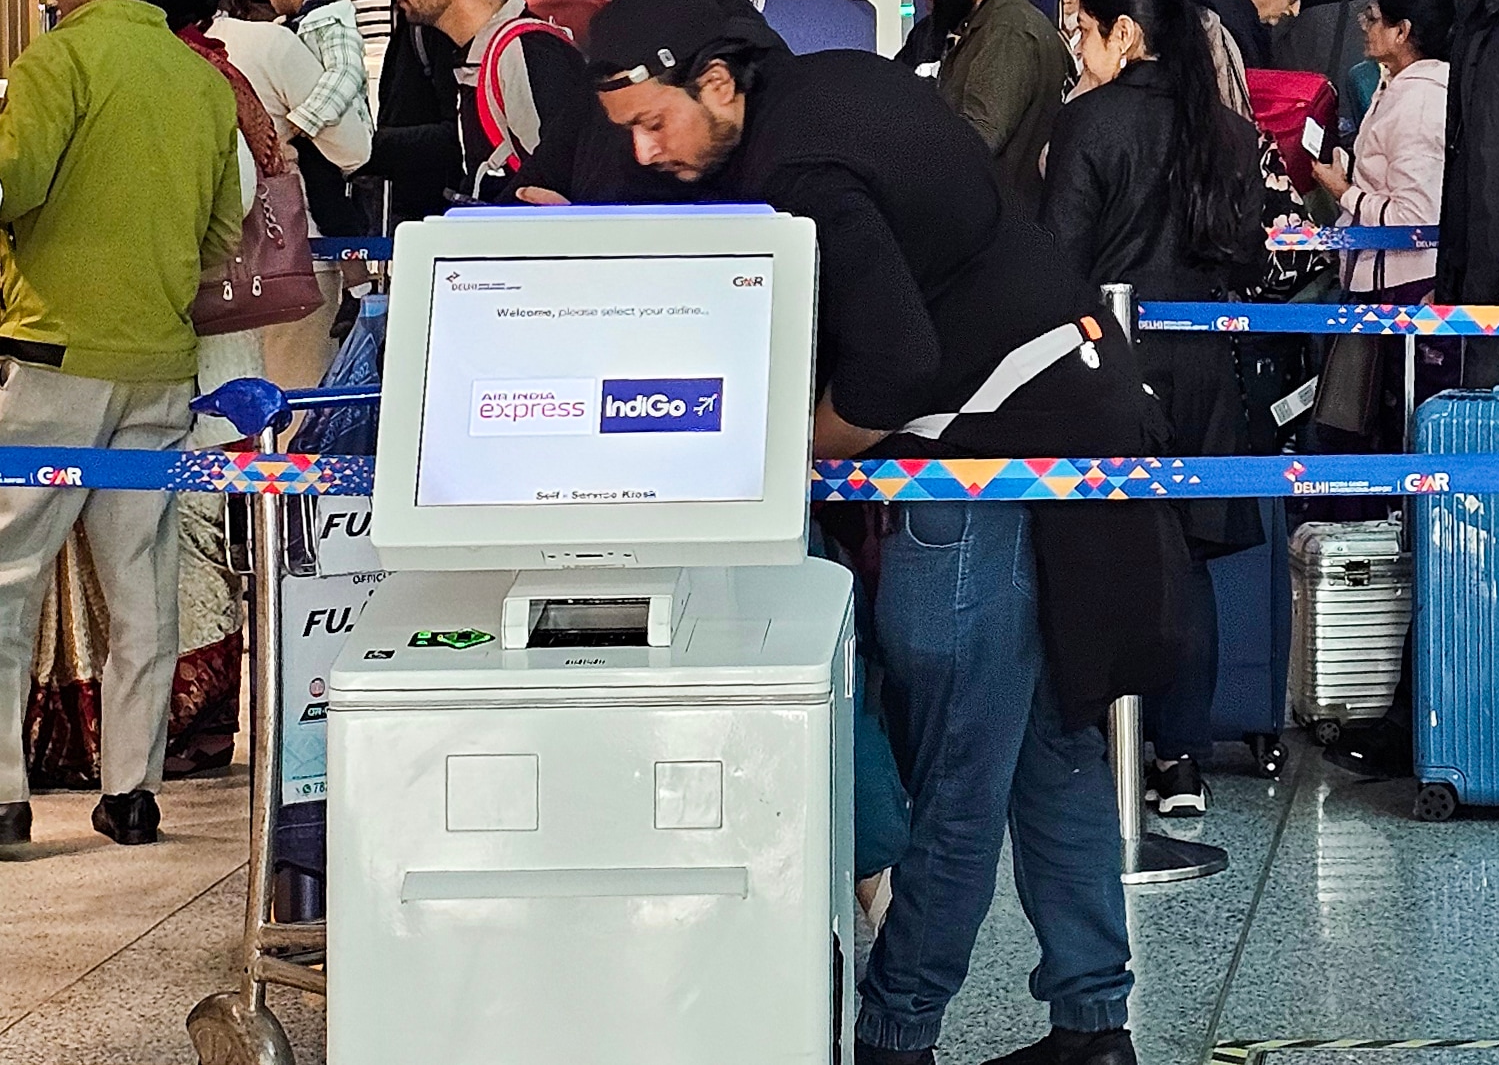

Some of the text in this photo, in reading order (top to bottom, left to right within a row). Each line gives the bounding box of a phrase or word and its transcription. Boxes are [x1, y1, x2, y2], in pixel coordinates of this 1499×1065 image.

[497, 307, 556, 318] Welcome,
[557, 306, 598, 318] please
[600, 306, 635, 317] select
[638, 307, 663, 319] your
[481, 391, 555, 401] AIR INDIA
[605, 393, 686, 418] IndiGo
[479, 400, 585, 422] express
[1293, 481, 1329, 494] DELHI
[321, 511, 372, 539] FU
[302, 607, 354, 638] FU
